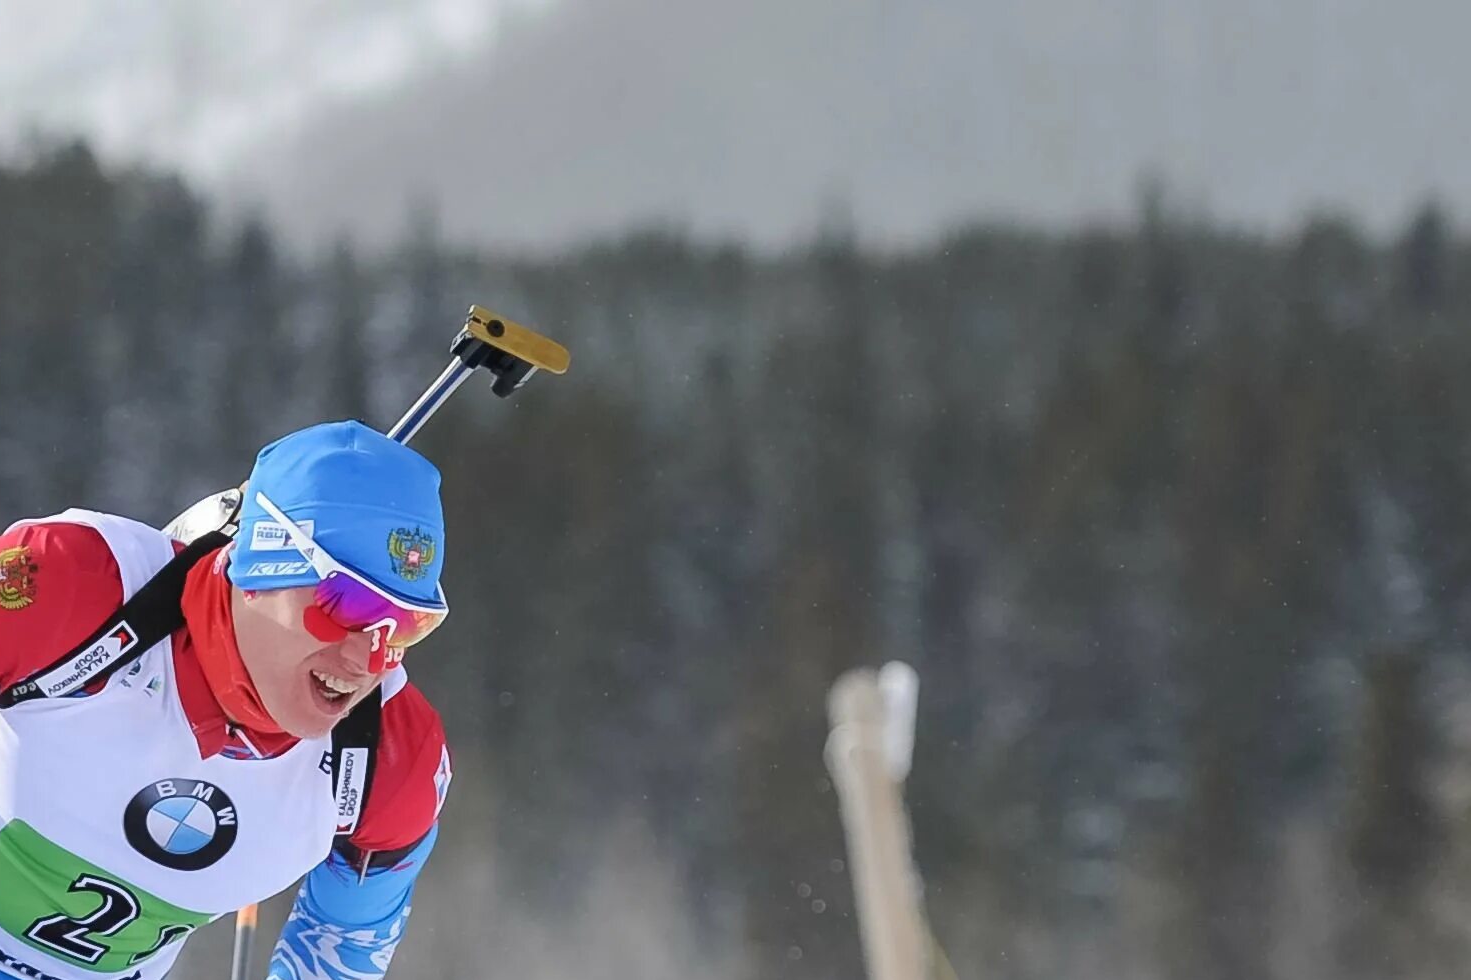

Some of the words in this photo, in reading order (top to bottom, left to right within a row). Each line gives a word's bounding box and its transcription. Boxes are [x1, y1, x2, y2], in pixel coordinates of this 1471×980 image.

[47, 650, 111, 696] KALASHNIKOV
[74, 644, 105, 671] GROUP
[155, 780, 236, 826] BMW
[338, 751, 355, 817] KALASHNIKOV
[345, 787, 359, 818] GROUP
